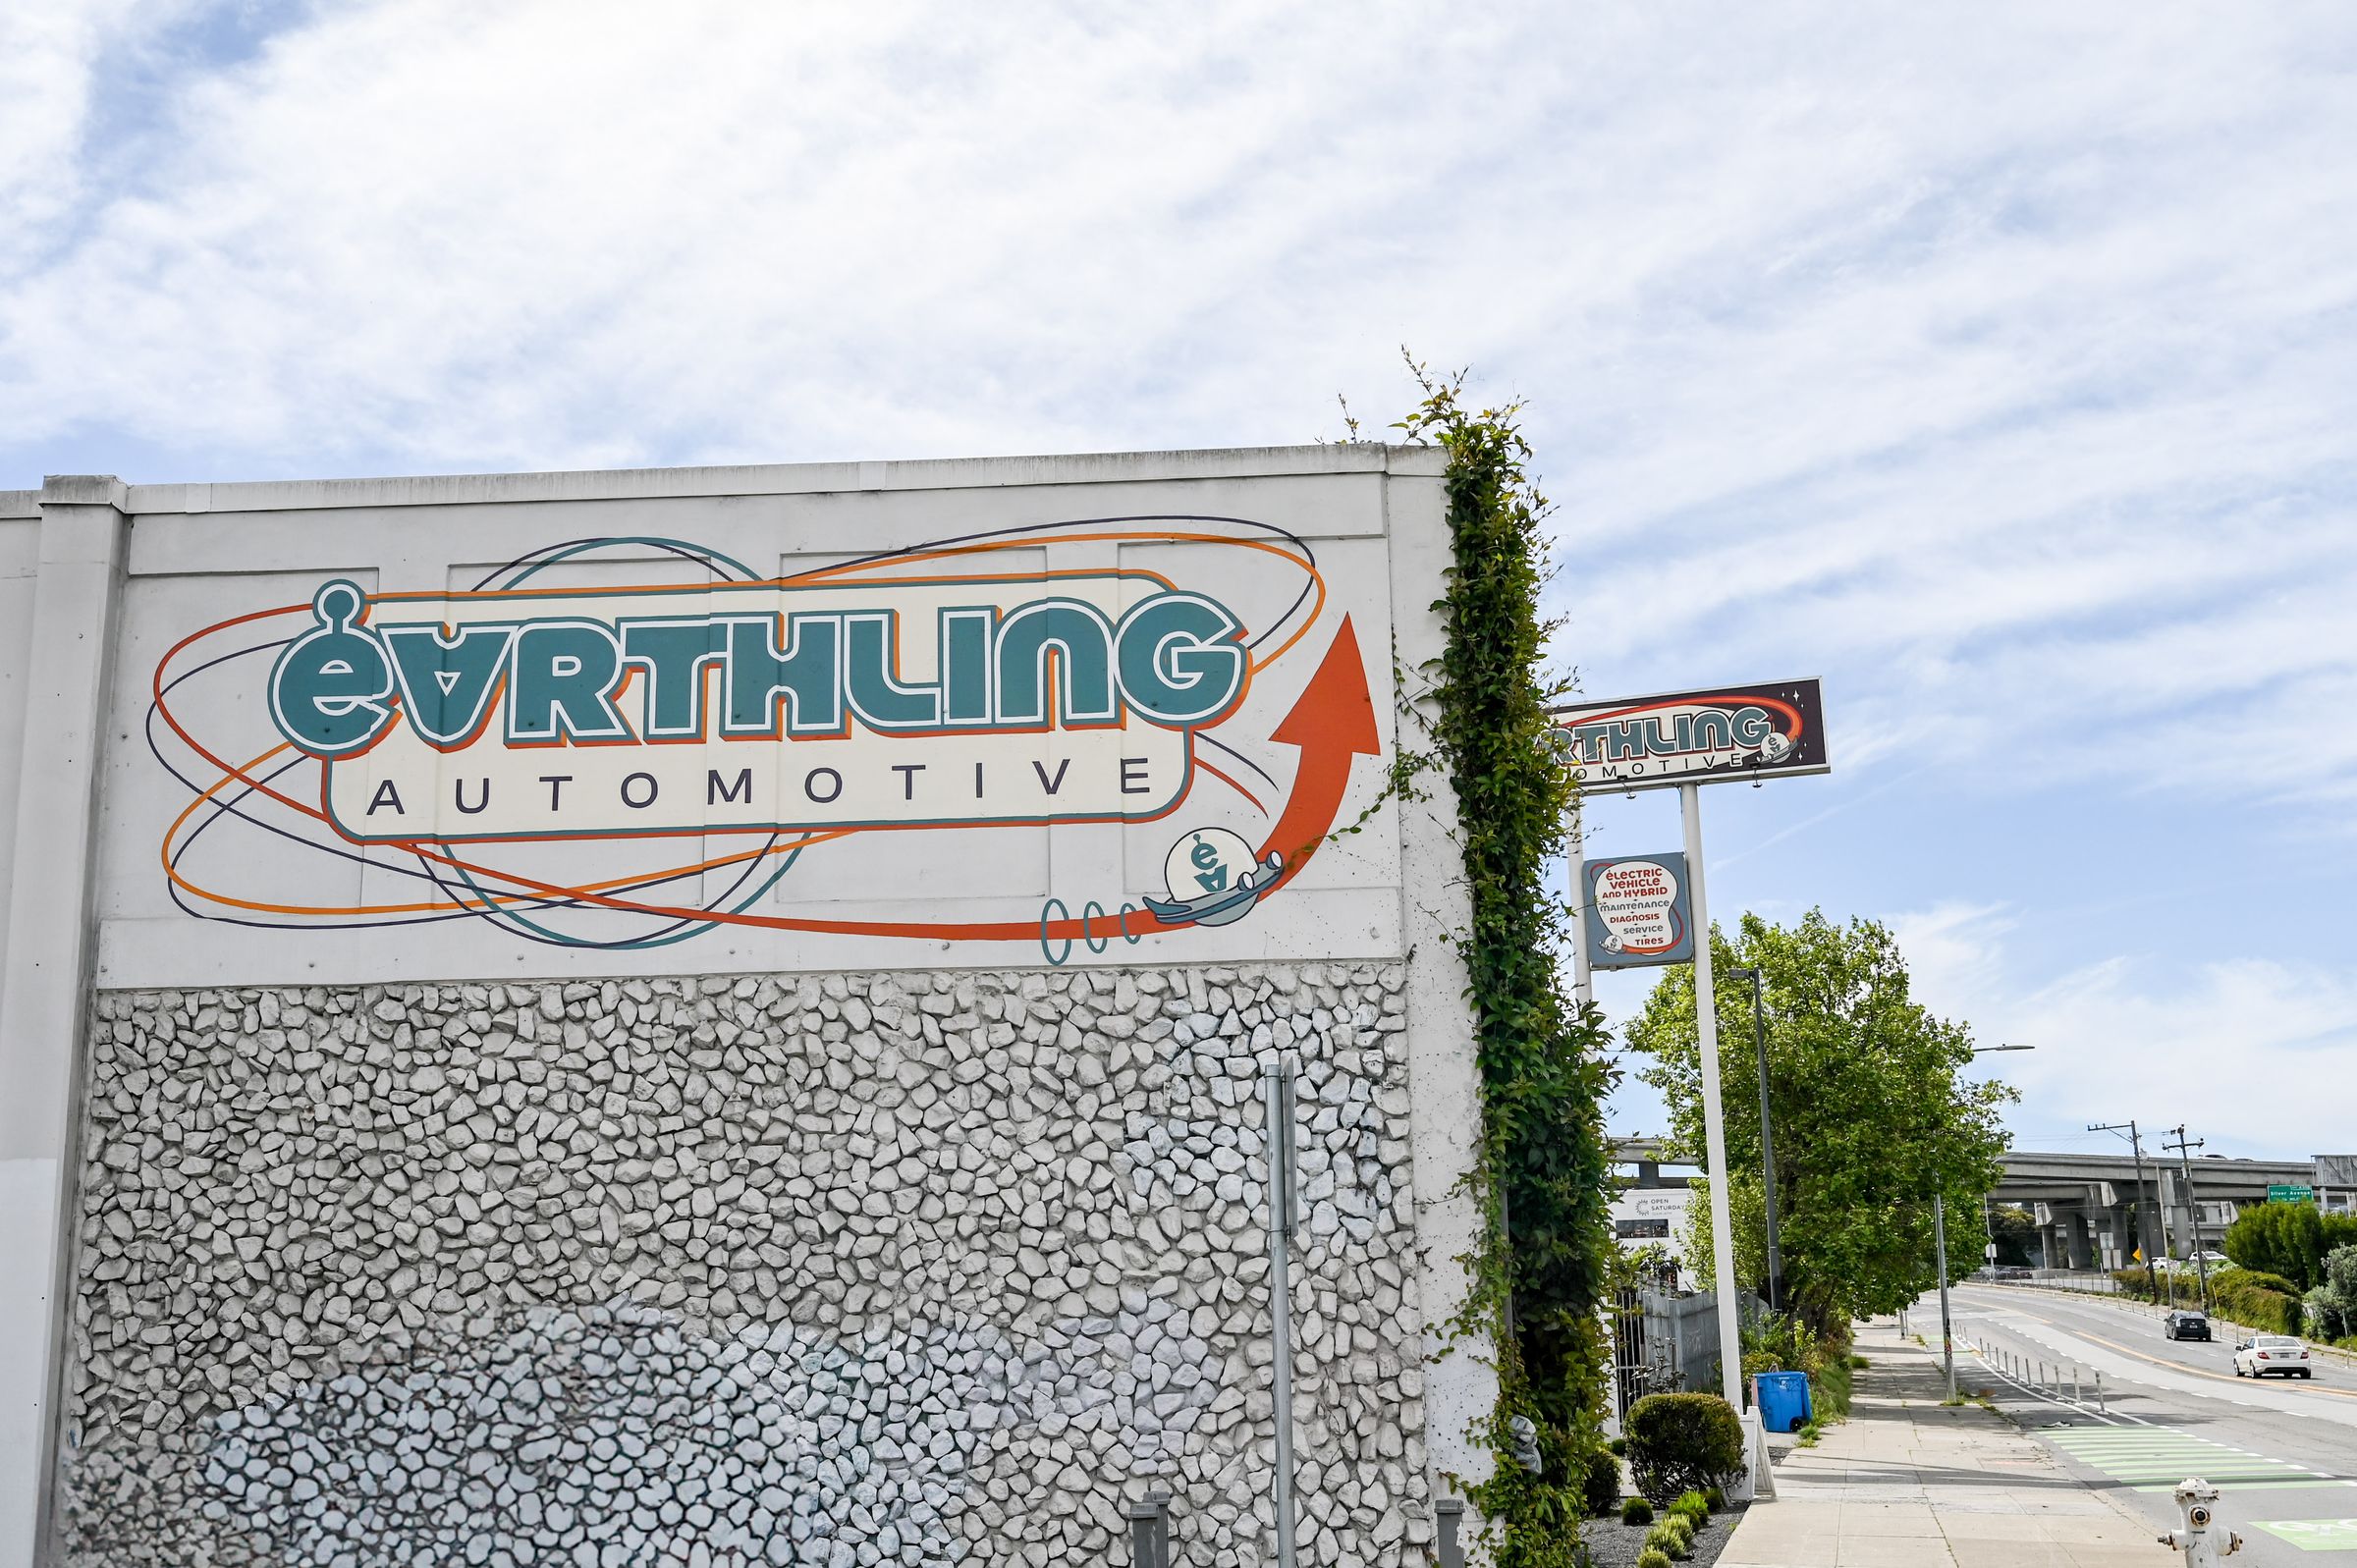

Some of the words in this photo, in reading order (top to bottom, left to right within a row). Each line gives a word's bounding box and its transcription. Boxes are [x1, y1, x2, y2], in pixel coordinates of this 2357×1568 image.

[1574, 752, 1741, 780] OMOTIVE
[366, 757, 1150, 815] AUTOMOTIVE
[1623, 887, 1668, 898] HYBRID
